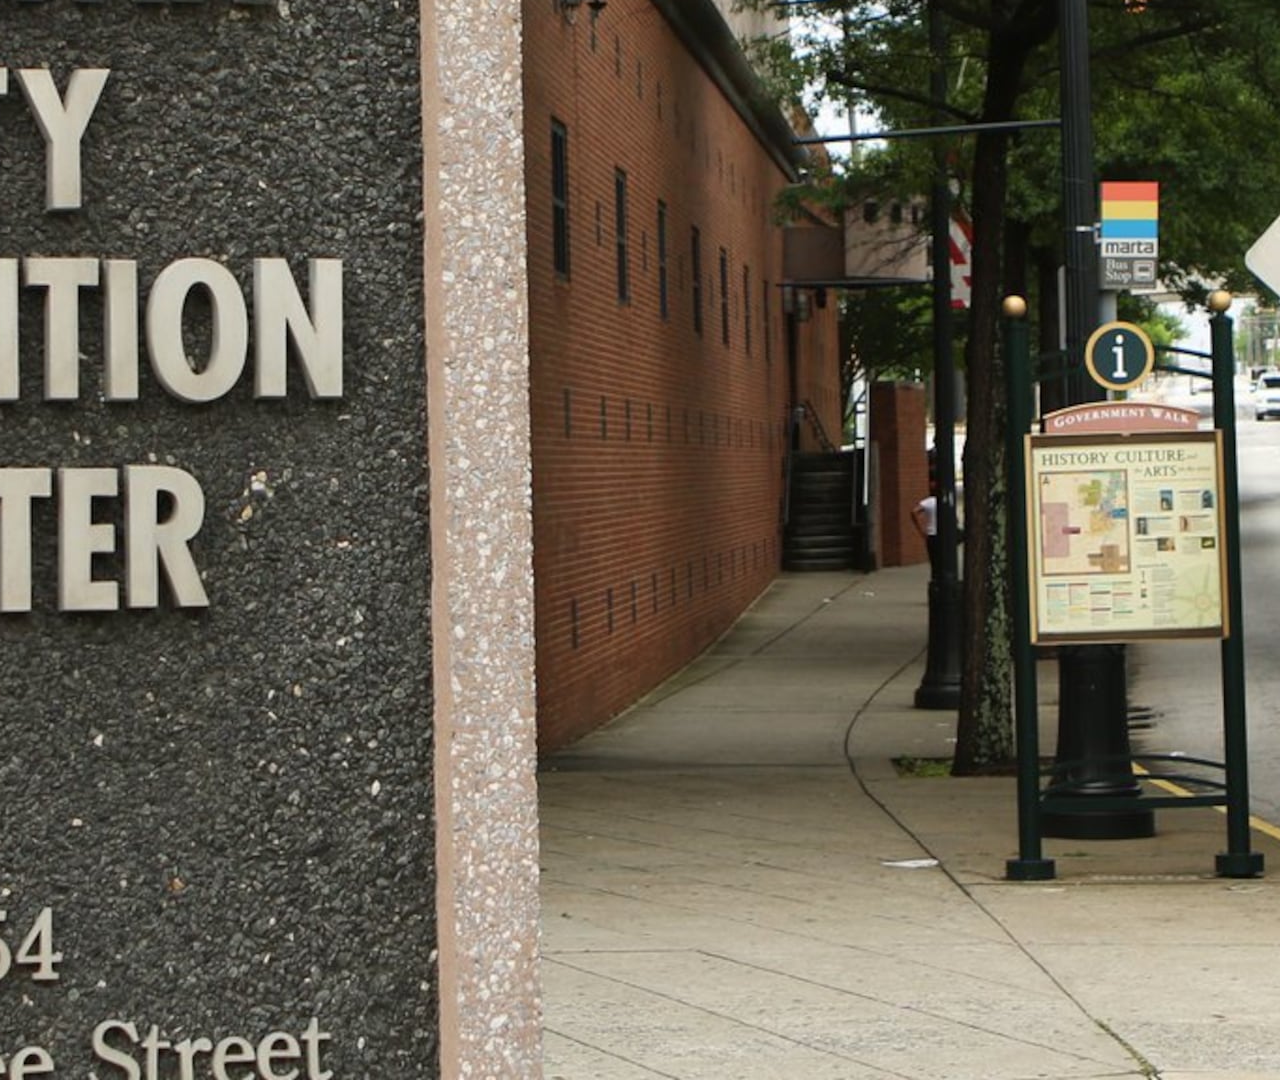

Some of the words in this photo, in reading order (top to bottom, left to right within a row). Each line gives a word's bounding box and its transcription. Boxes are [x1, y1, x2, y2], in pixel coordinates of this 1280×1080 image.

[1105, 241, 1154, 253] marta
[1105, 270, 1132, 284] Stop
[1053, 408, 1146, 428] GOVERNMENT
[1150, 408, 1190, 424] WALK
[1041, 452, 1109, 466] HISTORY
[1114, 449, 1186, 463] CULTURE
[1143, 465, 1178, 477] ARTS
[90, 1017, 334, 1080] Street
